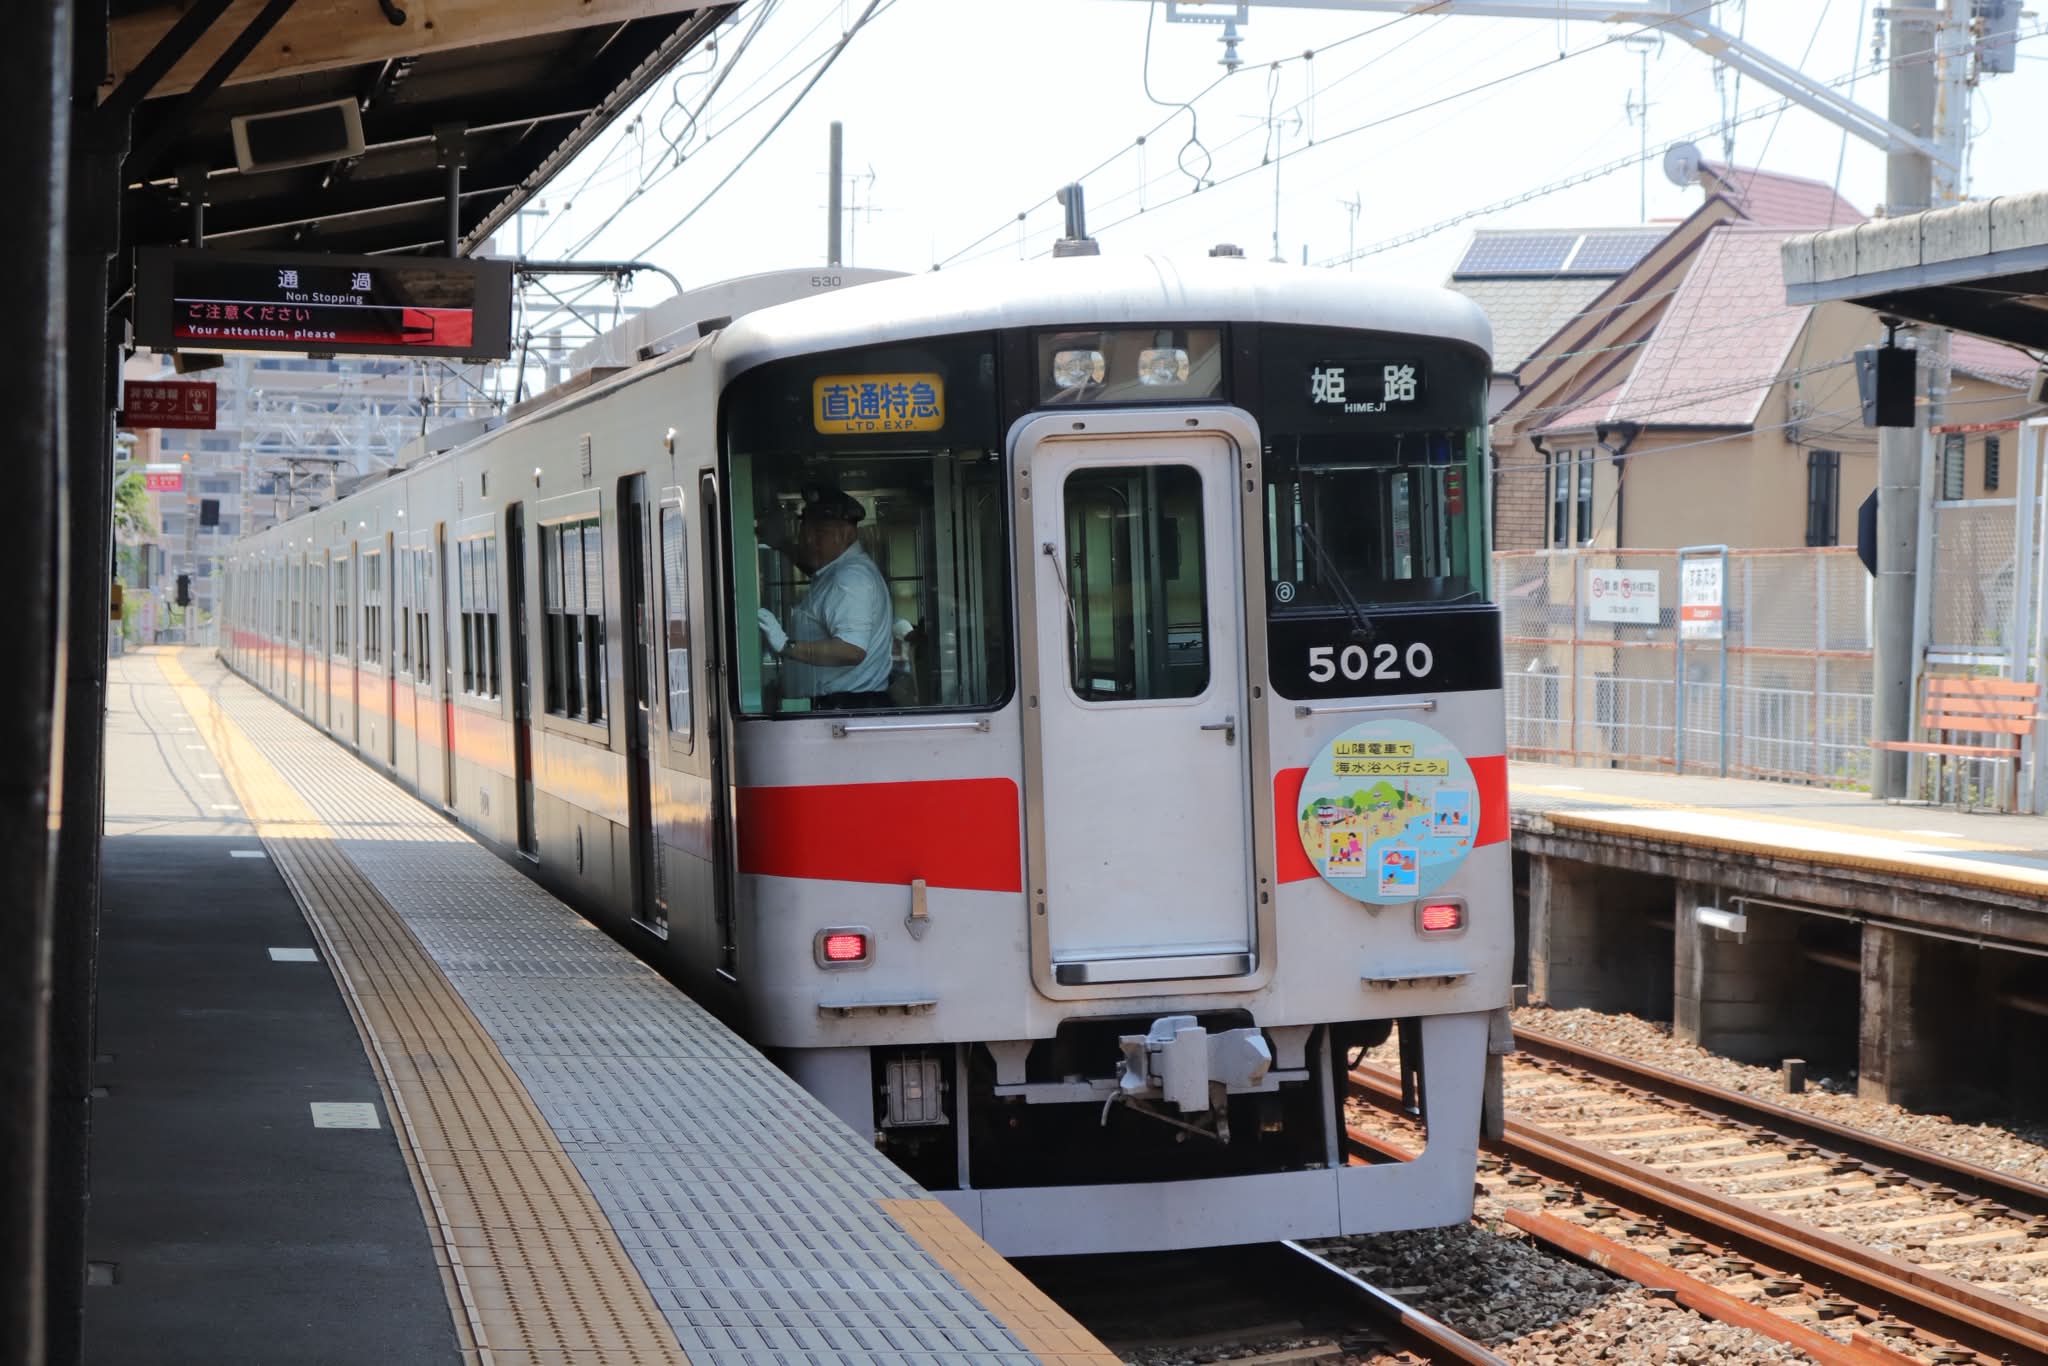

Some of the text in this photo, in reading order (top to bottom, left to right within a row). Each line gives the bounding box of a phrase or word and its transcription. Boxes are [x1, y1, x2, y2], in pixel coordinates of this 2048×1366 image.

[811, 276, 842, 287] 530
[286, 291, 364, 305] Non Stopping
[189, 303, 311, 321] ご注意ください
[188, 324, 337, 339] Your attention, please
[822, 381, 940, 421] 直通特急
[1344, 402, 1387, 413] HIMEJI
[845, 420, 918, 431] LTD. EXP.
[1308, 642, 1434, 683] 5020
[1335, 743, 1412, 755] 山陽電車で
[1335, 761, 1446, 774] 海水浴へ行こう。
